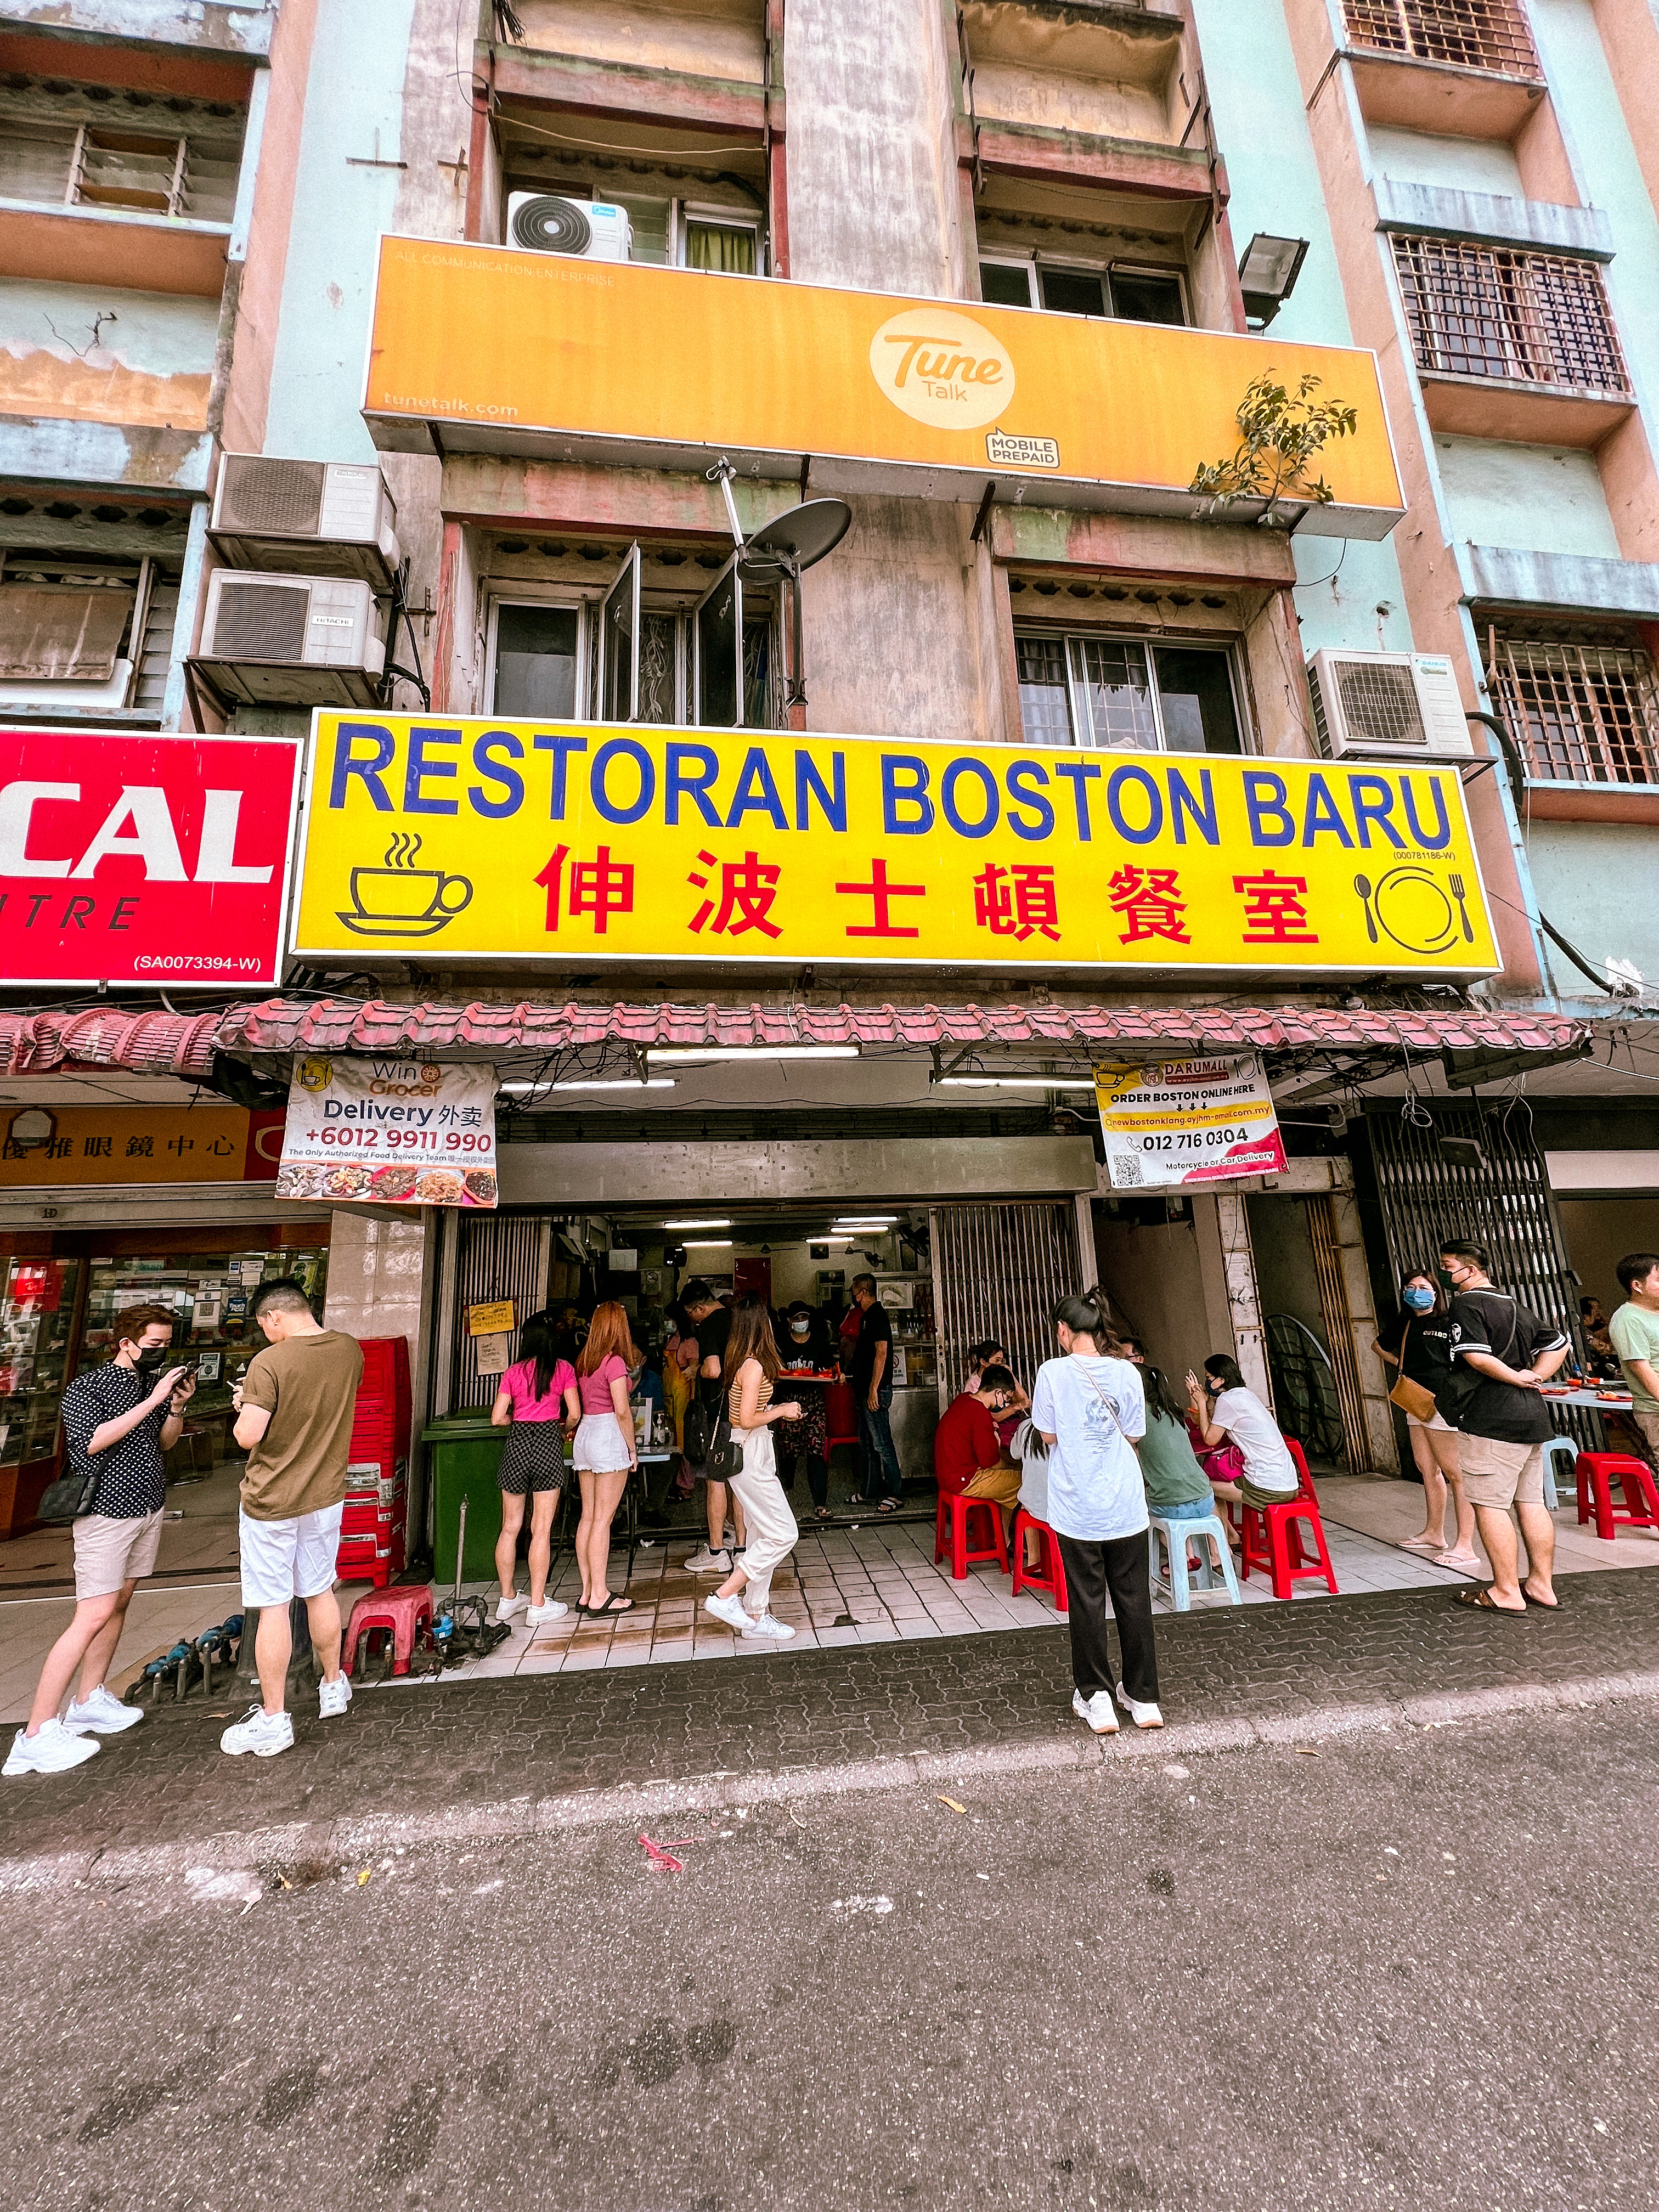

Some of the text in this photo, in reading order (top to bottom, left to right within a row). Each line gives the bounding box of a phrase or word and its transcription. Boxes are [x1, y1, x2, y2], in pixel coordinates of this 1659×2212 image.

[395, 251, 616, 286] ALL COMMUNICATION ENTERPRISE
[884, 335, 1004, 388] Tune
[922, 380, 968, 402] Talk
[384, 392, 518, 417] tunetalk.com
[991, 438, 1053, 453] MOBILE
[993, 449, 1055, 463] PREPAID
[330, 724, 1451, 850] RESTORAN BOSTON BARU
[0, 781, 274, 883] CAL
[1393, 851, 1455, 861] (000781186-W)
[534, 844, 1320, 945] 伸波士頓餐室
[134, 955, 262, 974] (SA0073394-W)
[373, 1062, 416, 1080] Win
[1165, 1059, 1228, 1075] DARUMALL
[369, 1079, 442, 1097] Grocer
[1110, 1084, 1256, 1103] ORDER BOSTON ONLINE HERE
[324, 1099, 482, 1127] Delivery 外卖
[307, 1127, 379, 1147] +6012
[387, 1129, 437, 1149] 9911
[445, 1132, 492, 1152] 990
[1143, 1127, 1249, 1151] 012 716 0304
[392, 1152, 424, 1161] Delivery
[1166, 1160, 1208, 1171] Motorcycle
[1237, 1151, 1274, 1163] Delivery
